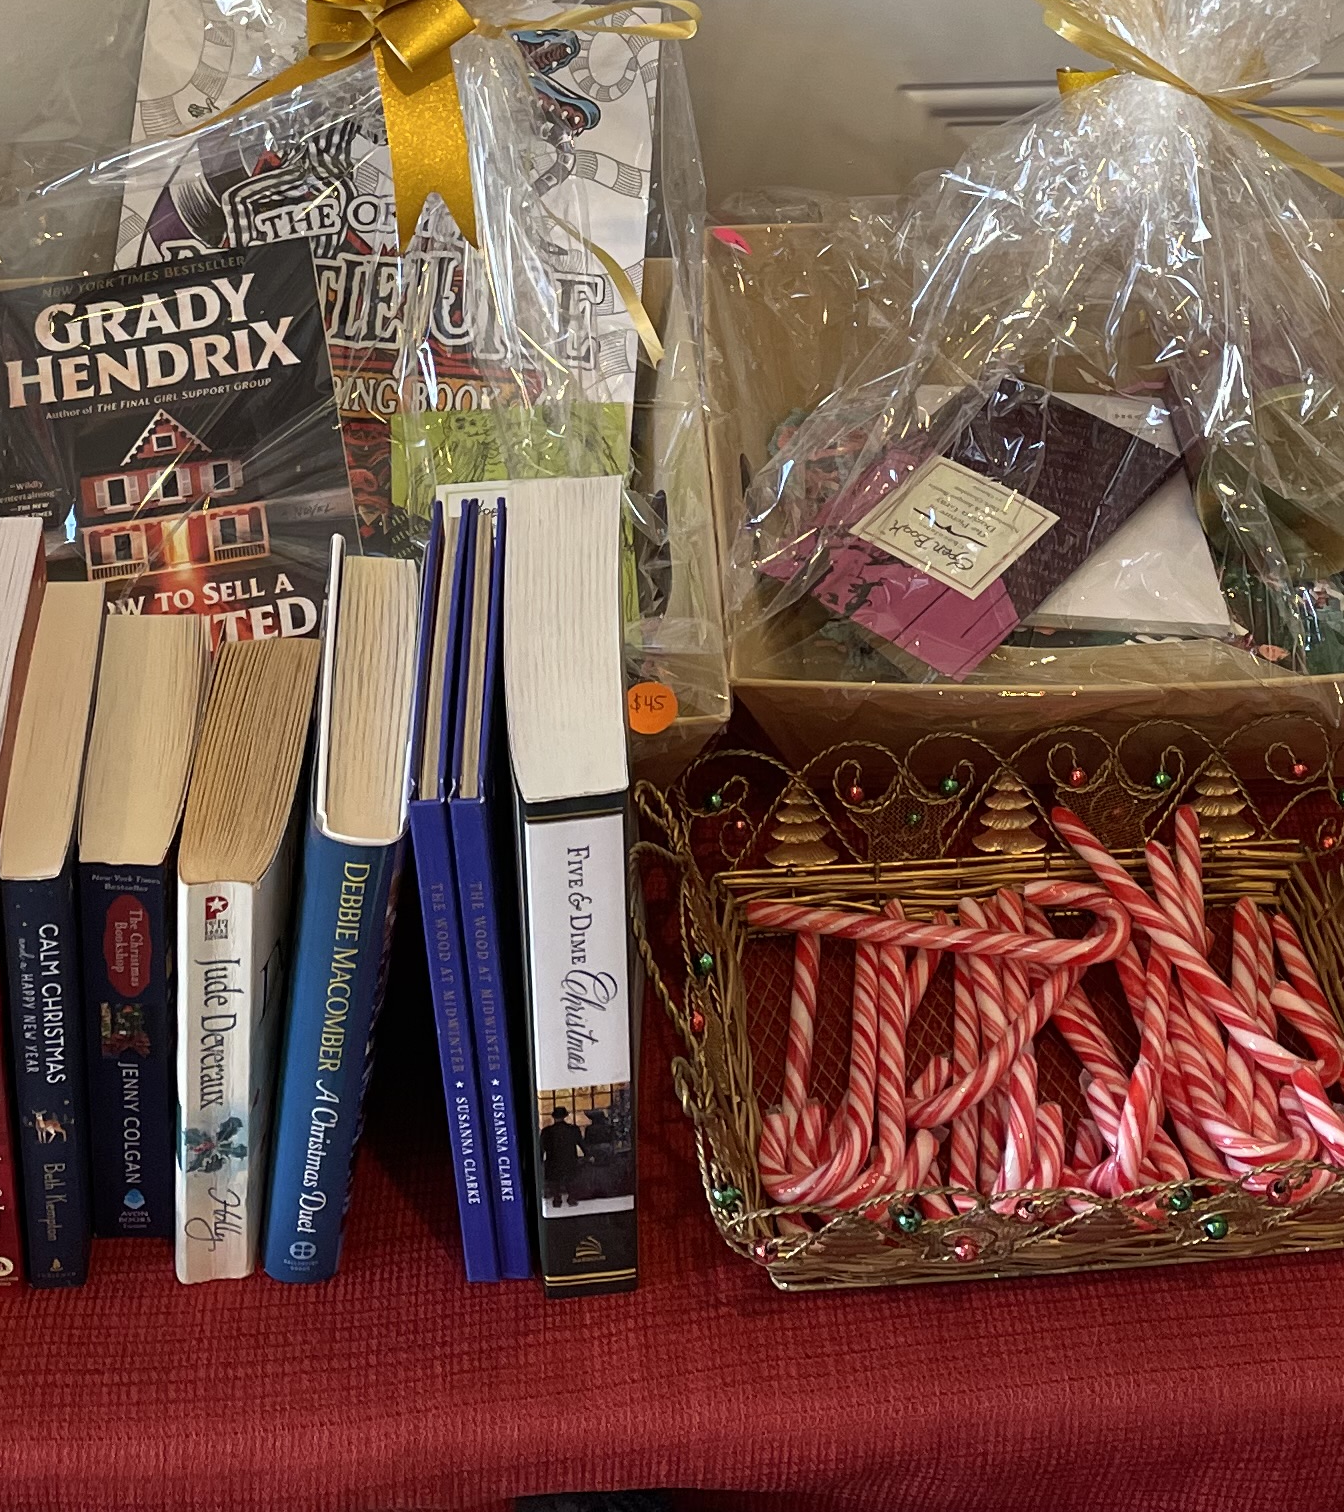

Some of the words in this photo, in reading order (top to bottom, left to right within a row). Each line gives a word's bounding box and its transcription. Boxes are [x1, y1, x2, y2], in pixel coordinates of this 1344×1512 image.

[260, 204, 340, 241] THE
[42, 285, 73, 299] NEW
[76, 279, 114, 295] YORK
[118, 271, 159, 286] TIMES
[164, 255, 246, 279] BESTSELLER
[34, 273, 255, 352] GRADY
[4, 316, 301, 408] HENDRIX
[46, 408, 81, 420] Author
[82, 405, 94, 416] of
[97, 402, 117, 413] THE
[121, 398, 151, 410] FINAL
[154, 393, 179, 405] GIRL
[182, 385, 230, 401] SUPPORT
[234, 377, 272, 391] GROUP
[888, 519, 931, 550] Book
[154, 589, 195, 613] TO
[202, 577, 266, 605] SELL
[274, 573, 295, 594] A
[630, 693, 667, 713] $45
[567, 845, 591, 889] FIVE
[334, 861, 371, 942] DEBBIE
[431, 882, 447, 912] THE
[469, 881, 485, 910] THE
[568, 891, 593, 912] &
[129, 909, 143, 930] The
[435, 917, 452, 962] WOOD
[473, 915, 490, 960] WOOD
[569, 913, 593, 965] DIME
[38, 923, 61, 976] CALM
[111, 921, 129, 973] Bookshop
[129, 933, 144, 987] Christmas
[21, 973, 36, 1009] HAPPY
[194, 958, 244, 1008] Jude
[440, 966, 454, 984] AT
[478, 965, 492, 983] AT
[23, 1014, 37, 1040] NEW
[41, 982, 66, 1084] CHRISTMAS
[318, 946, 360, 1073] MACOMBER
[443, 990, 465, 1074] MIDWINTER
[481, 989, 501, 1072] MIDWINTER
[560, 968, 618, 1074] Christmas
[24, 1045, 39, 1073] YEAR
[199, 1012, 238, 1111] Deveraux
[117, 1061, 140, 1113] JENNY
[315, 1078, 341, 1104] A
[301, 1105, 339, 1188] Christmas
[456, 1096, 474, 1155] SUSANNA
[491, 1094, 509, 1153] SUSANNA
[123, 1116, 142, 1184] COLGAN
[43, 1162, 66, 1191] Beth
[463, 1158, 481, 1205] CLARKE
[498, 1156, 515, 1202] CLARKE
[184, 1186, 243, 1253] Holly
[296, 1187, 327, 1234] Duet
